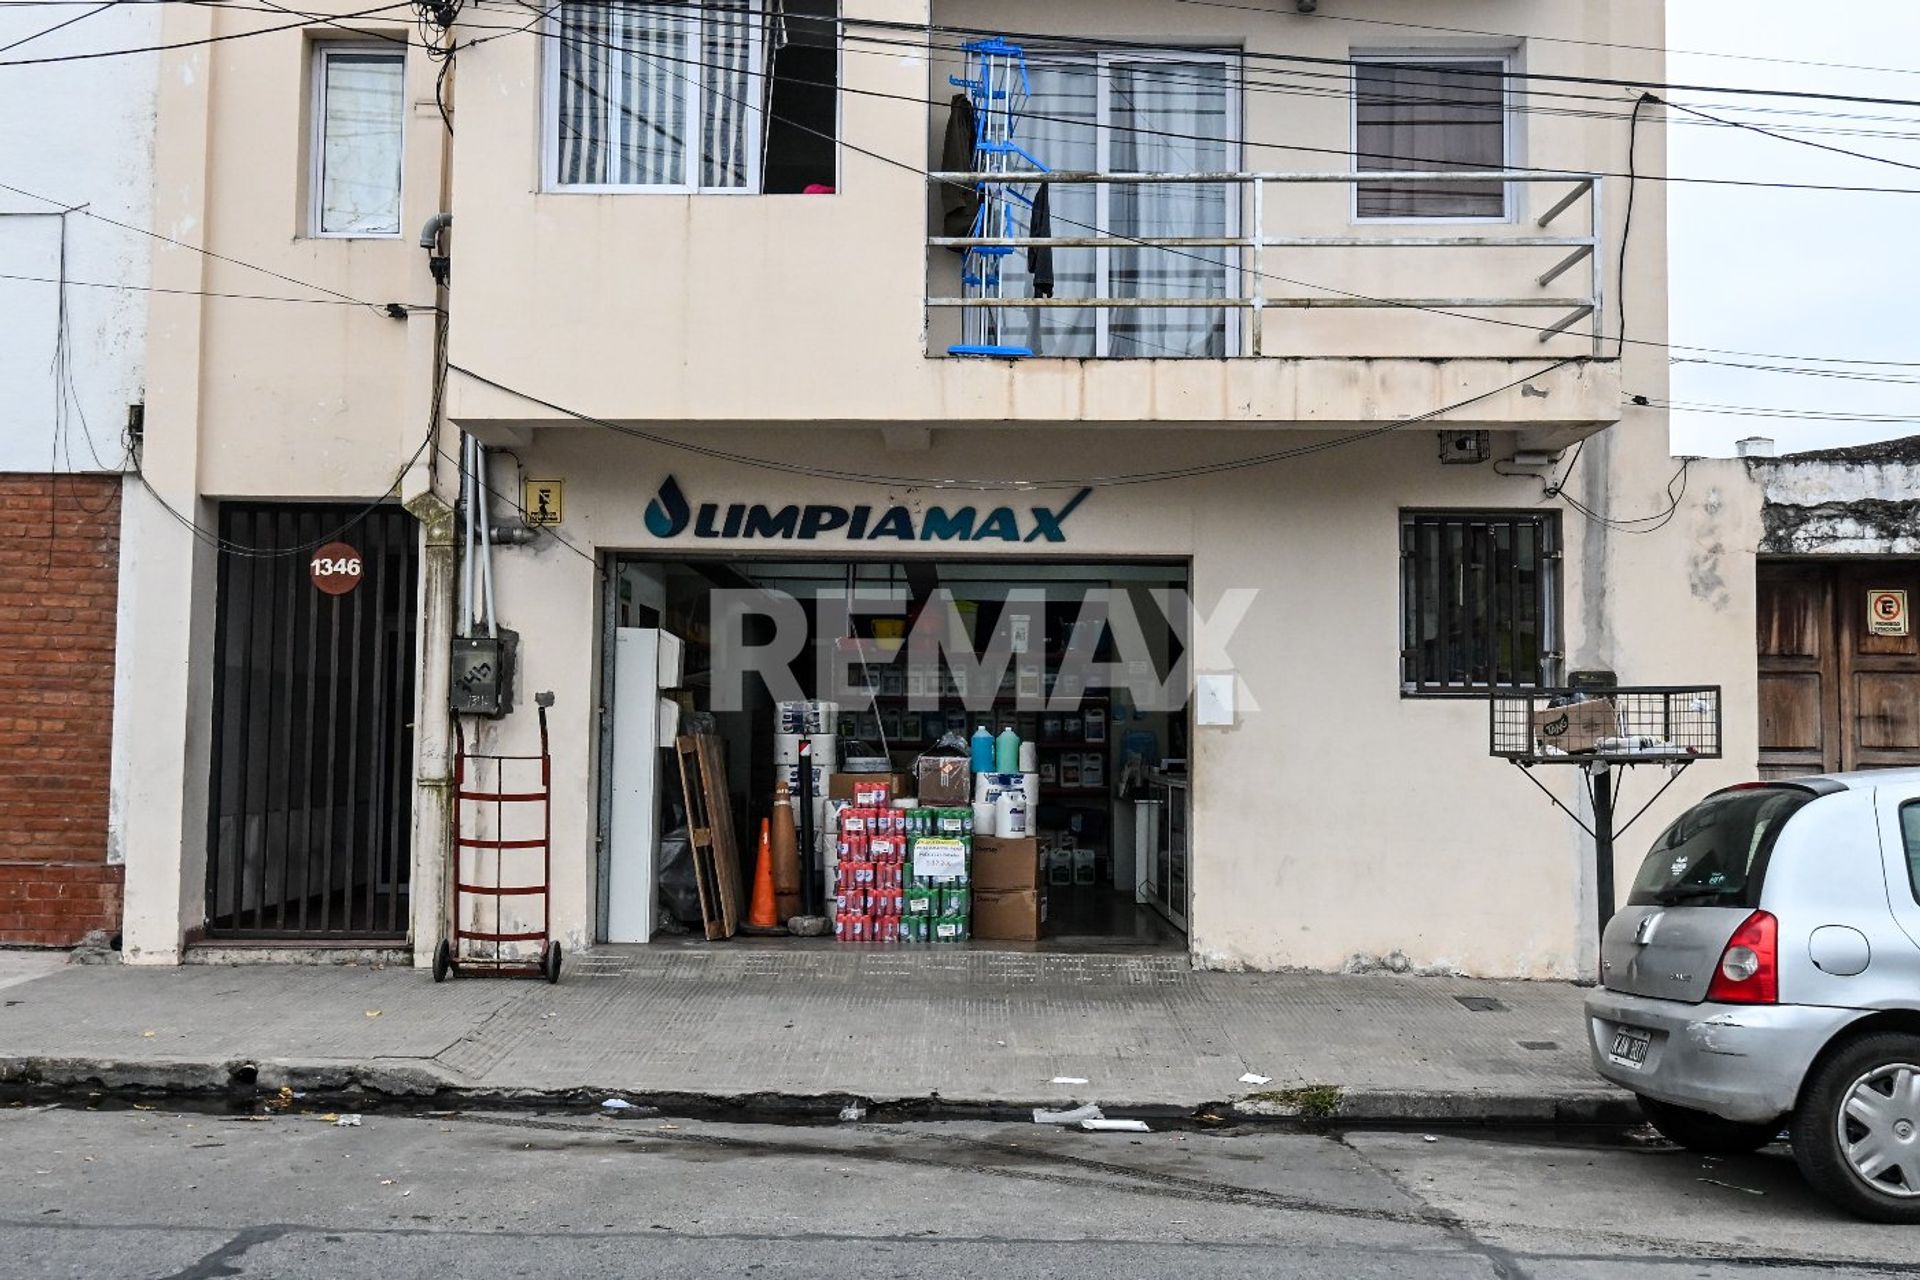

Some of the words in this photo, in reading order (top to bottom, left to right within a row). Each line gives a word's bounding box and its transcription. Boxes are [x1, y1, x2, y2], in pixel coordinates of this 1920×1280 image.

[693, 486, 1093, 543] LIMPIAMAX
[310, 558, 361, 576] 1346
[1882, 600, 1894, 614] E
[1545, 718, 1567, 734] TANG
